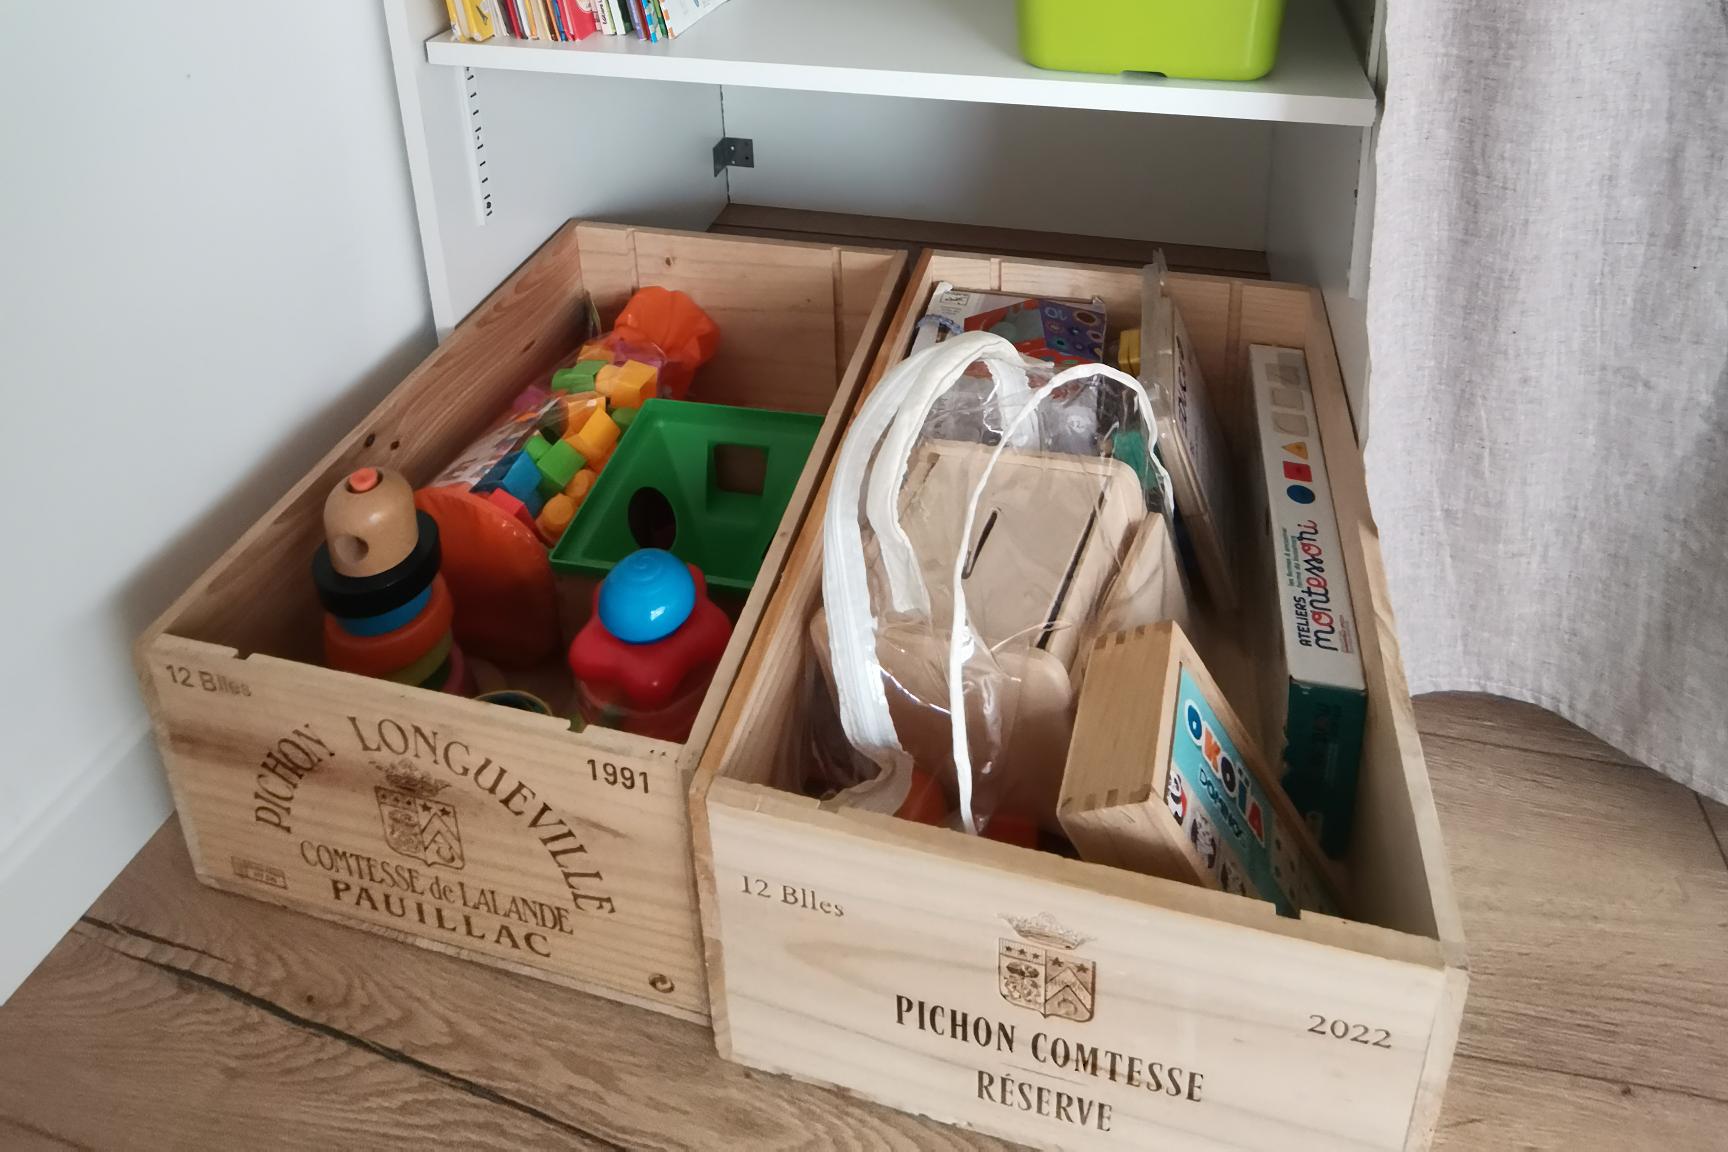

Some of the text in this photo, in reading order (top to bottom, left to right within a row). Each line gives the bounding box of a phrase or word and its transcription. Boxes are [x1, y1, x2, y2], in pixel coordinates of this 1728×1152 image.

[1297, 519, 1339, 651] montessori
[1293, 595, 1313, 647] ATELIERS
[166, 664, 194, 688] 12
[586, 758, 651, 794] 1991
[254, 715, 617, 915] PICHON LONGUEVILLE
[299, 840, 425, 895] COMTESSE
[430, 875, 455, 903] de
[457, 880, 575, 935] LALANDE
[330, 878, 552, 958] PAUILLAC
[740, 875, 772, 899] 12
[895, 993, 1204, 1103] PICHON COMTESSE
[1306, 1013, 1393, 1049] 2022
[976, 1070, 1114, 1132] RÉSERVE
